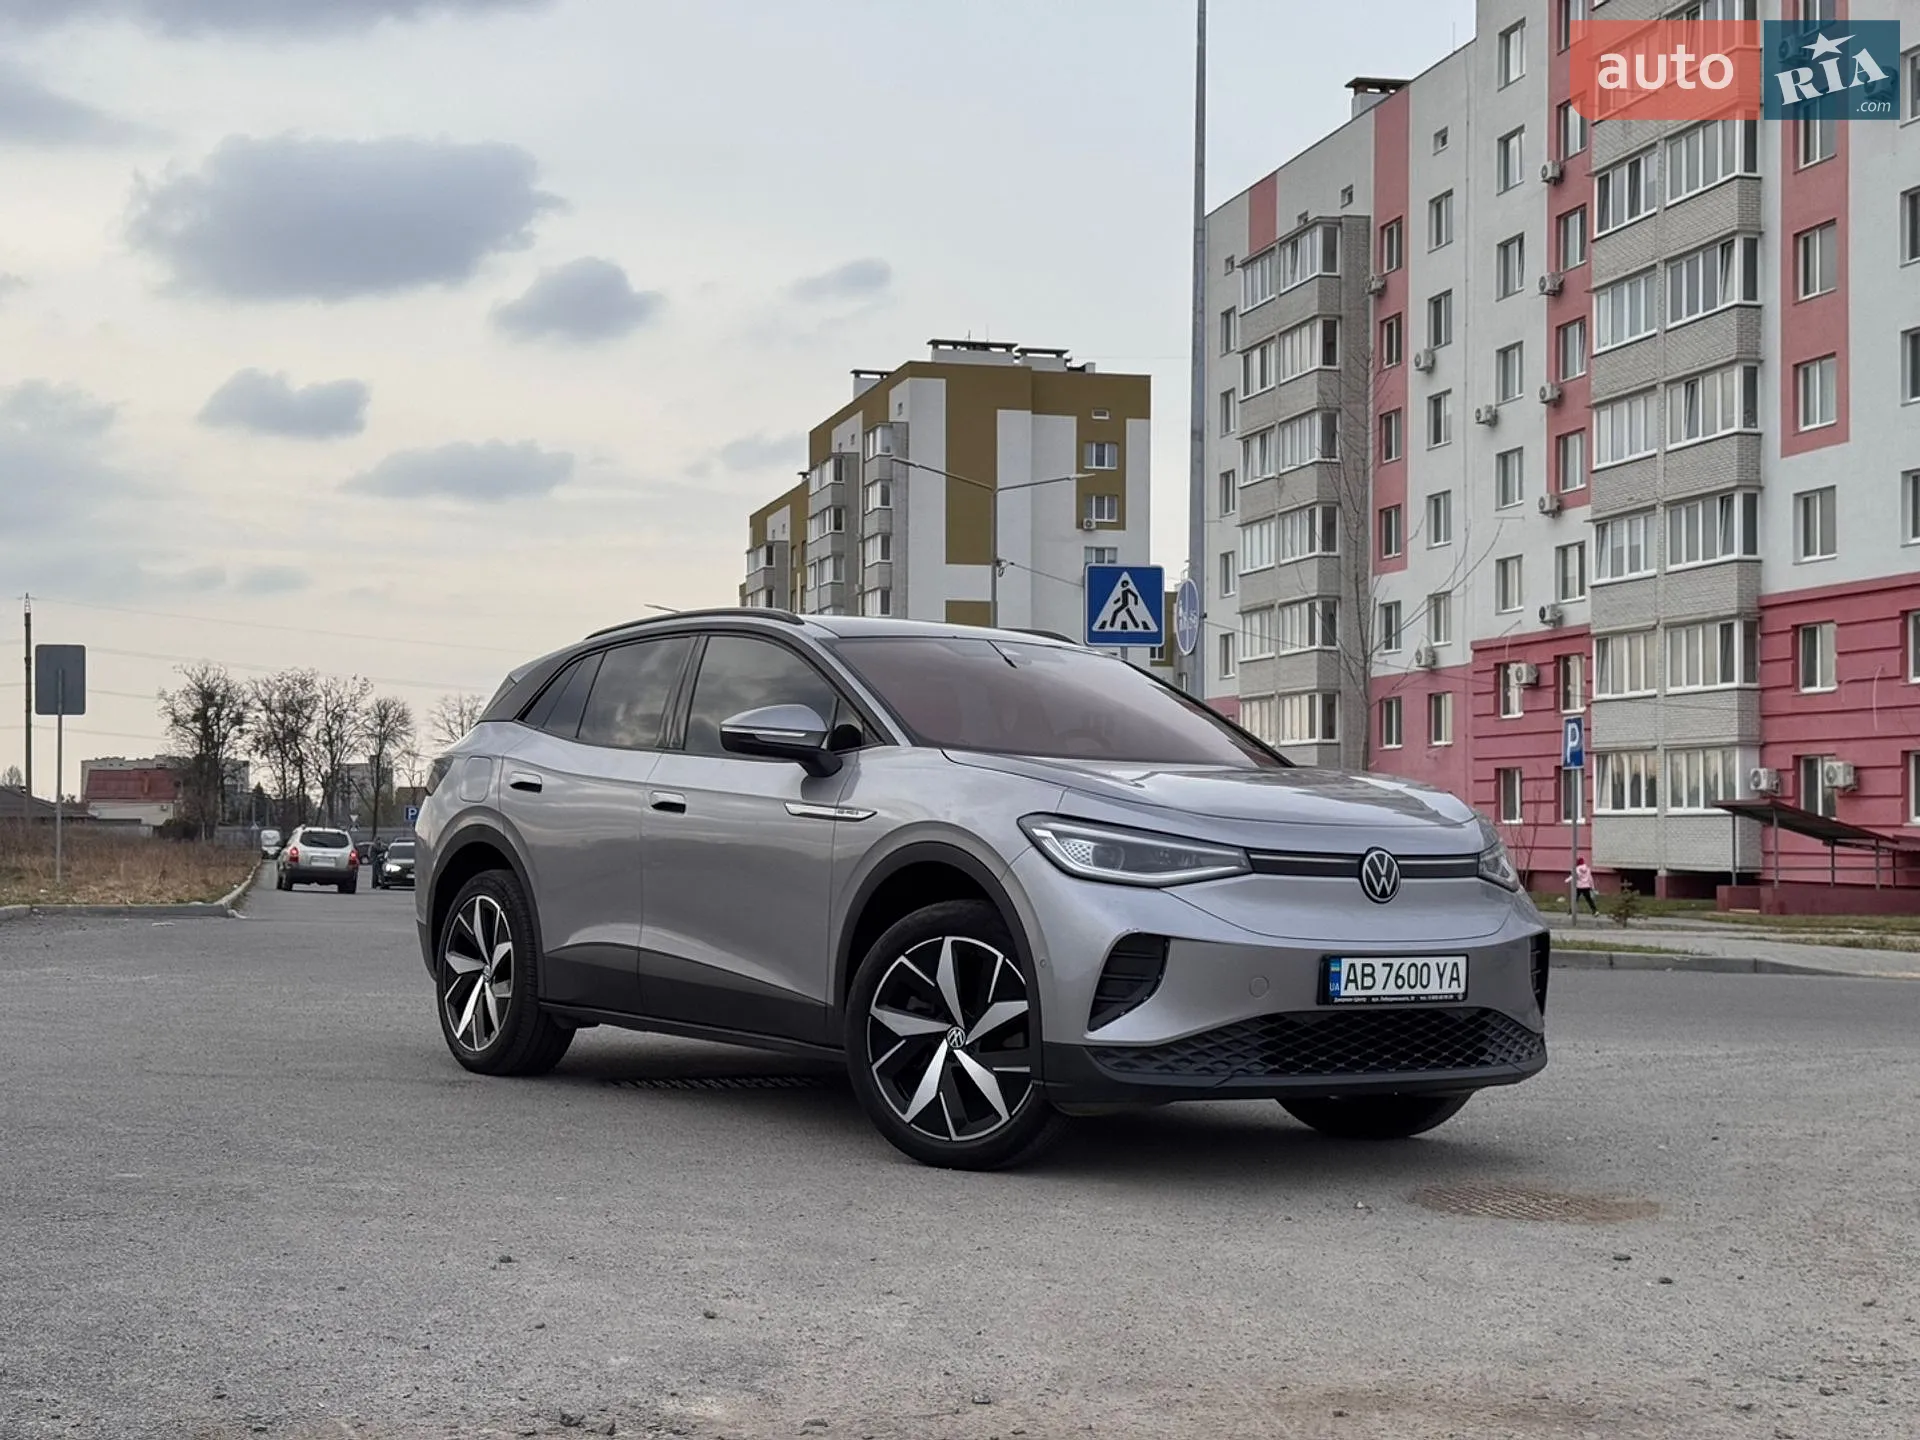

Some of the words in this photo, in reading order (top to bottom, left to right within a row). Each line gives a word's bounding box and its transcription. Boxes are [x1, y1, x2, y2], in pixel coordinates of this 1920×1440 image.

[1566, 722, 1580, 763] P
[408, 808, 417, 819] P
[1344, 962, 1376, 991] AB
[1381, 962, 1431, 991] 7600
[1435, 961, 1461, 989] YA
[1329, 982, 1340, 992] UA
